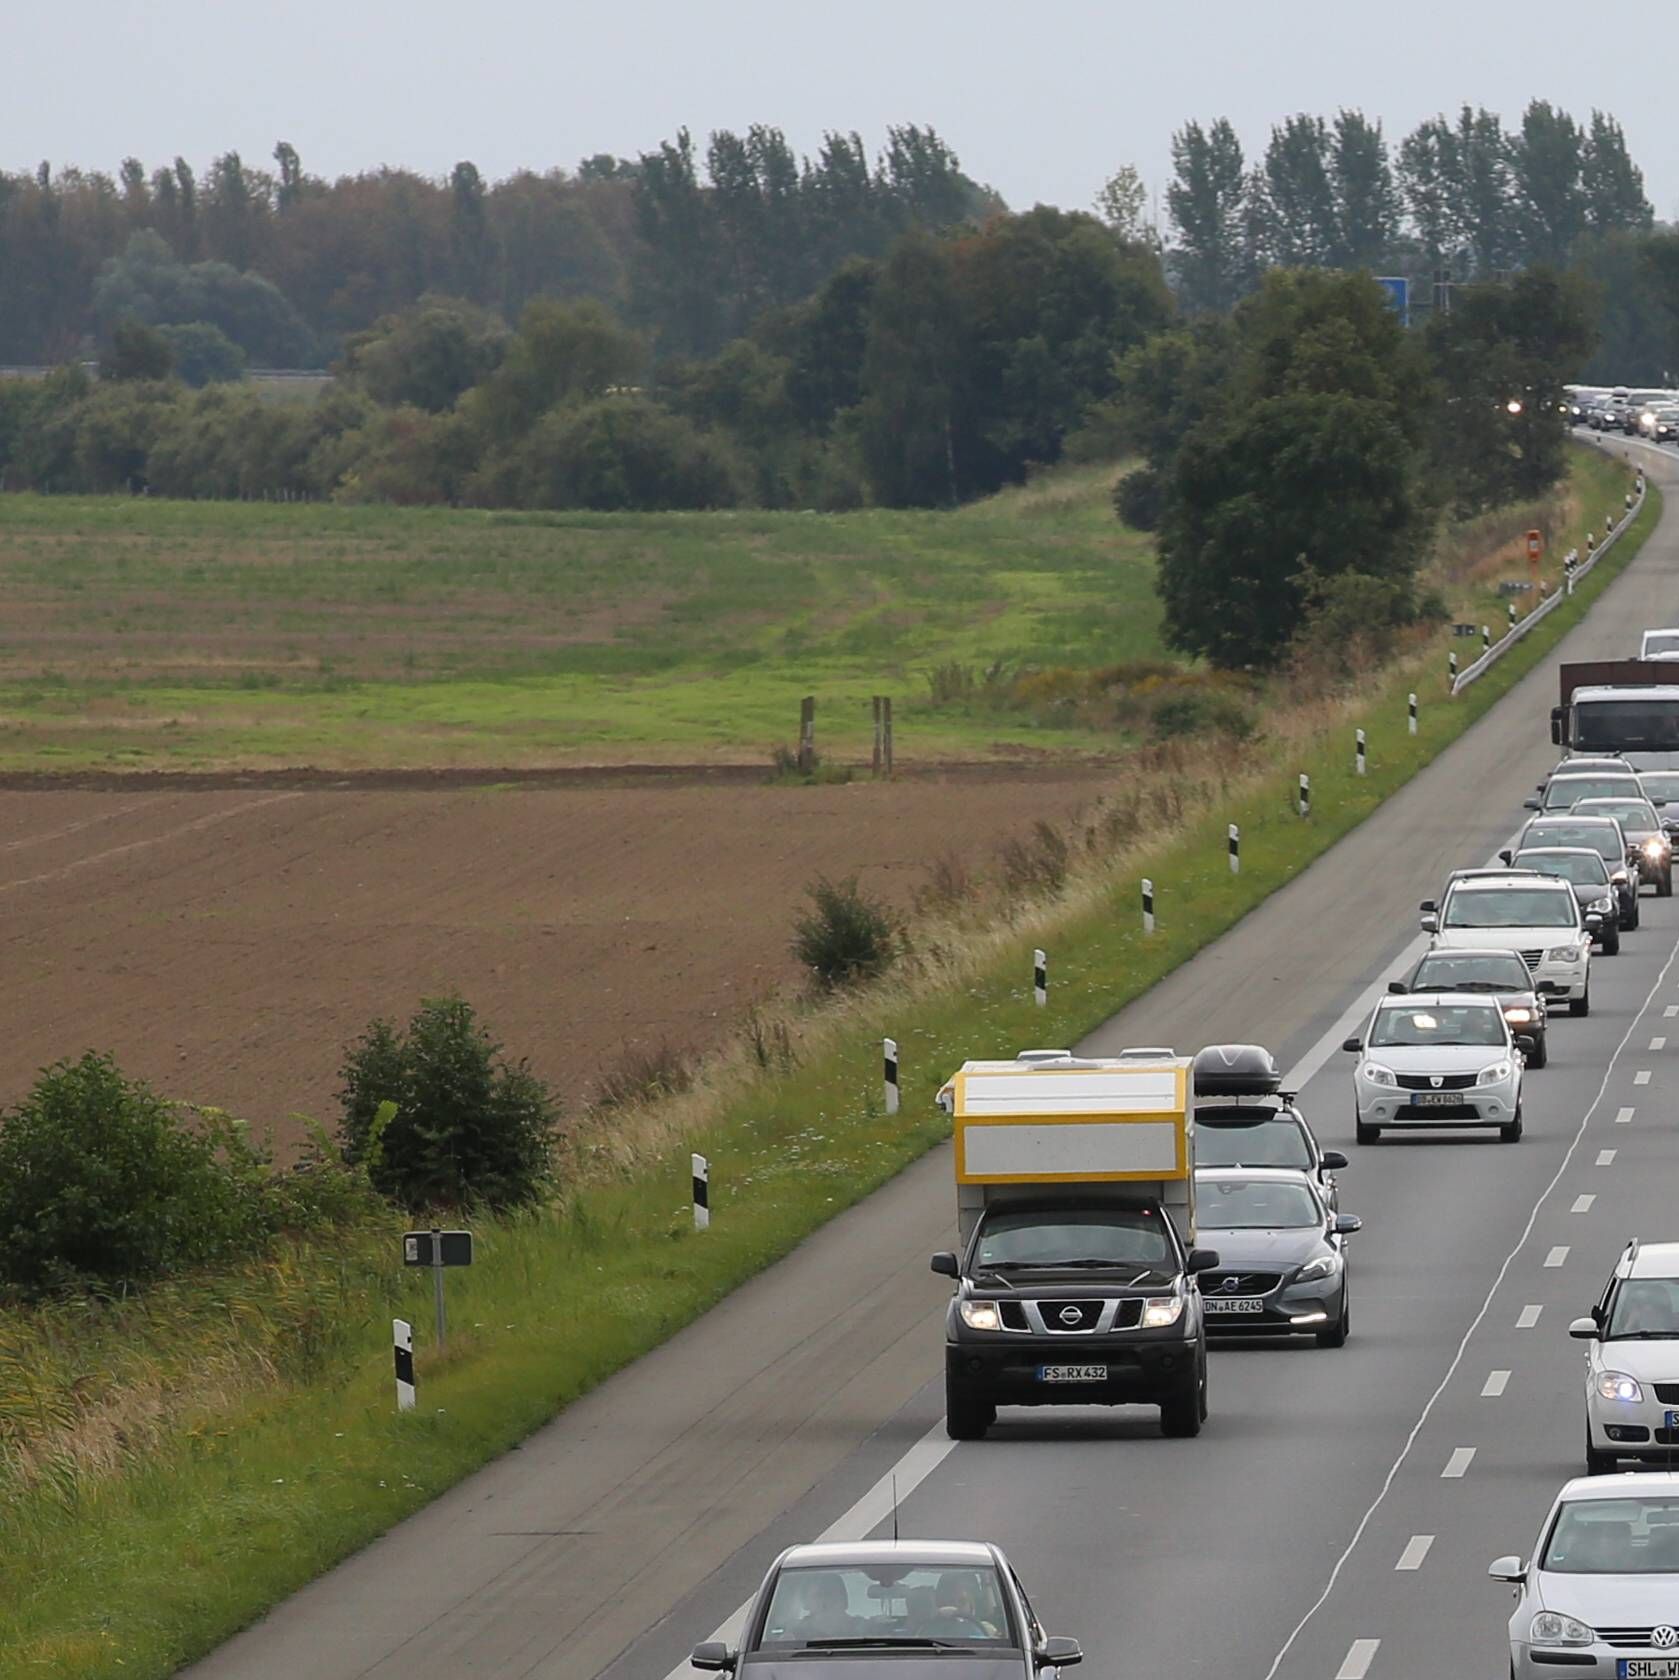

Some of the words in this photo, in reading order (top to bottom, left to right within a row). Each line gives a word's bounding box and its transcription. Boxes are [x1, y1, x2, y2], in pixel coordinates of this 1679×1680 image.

[1225, 1301, 1236, 1311] AE
[1238, 1301, 1262, 1311] 6245
[1044, 1368, 1060, 1379] FS
[1067, 1367, 1082, 1378] RX
[1084, 1367, 1105, 1378] 432
[1628, 1662, 1657, 1677] SHL
